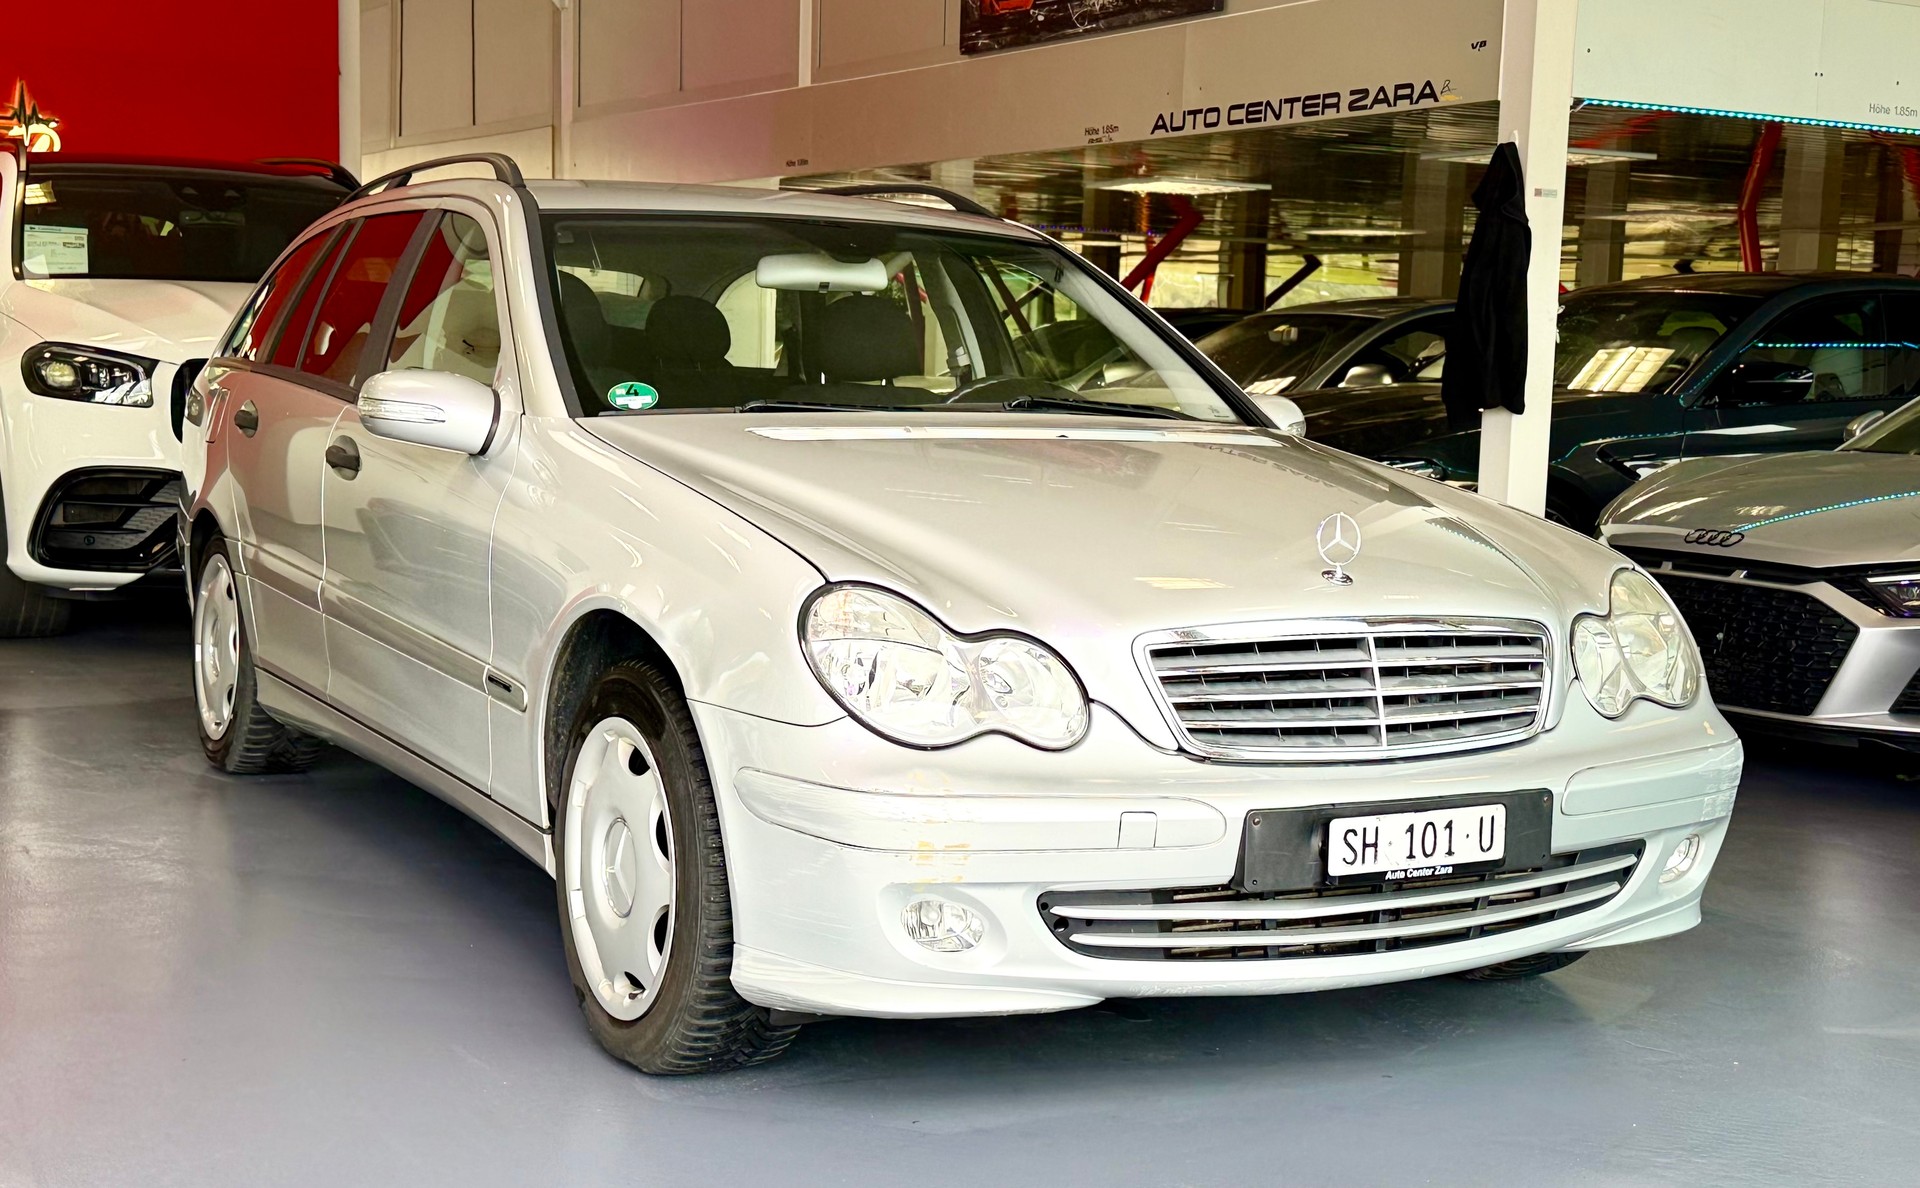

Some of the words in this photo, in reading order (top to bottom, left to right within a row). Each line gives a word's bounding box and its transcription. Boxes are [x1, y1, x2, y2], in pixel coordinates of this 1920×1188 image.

[1150, 107, 1221, 135] AUTO
[1227, 92, 1341, 125] CENTER
[1348, 80, 1440, 112] ZARA
[1869, 103, 1890, 115] Höhe
[1342, 826, 1379, 866] SH
[1405, 819, 1455, 859] 101
[1479, 815, 1495, 853] U
[1385, 869, 1406, 881] Auto
[1407, 867, 1435, 879] Center
[1435, 865, 1453, 876] Zara
